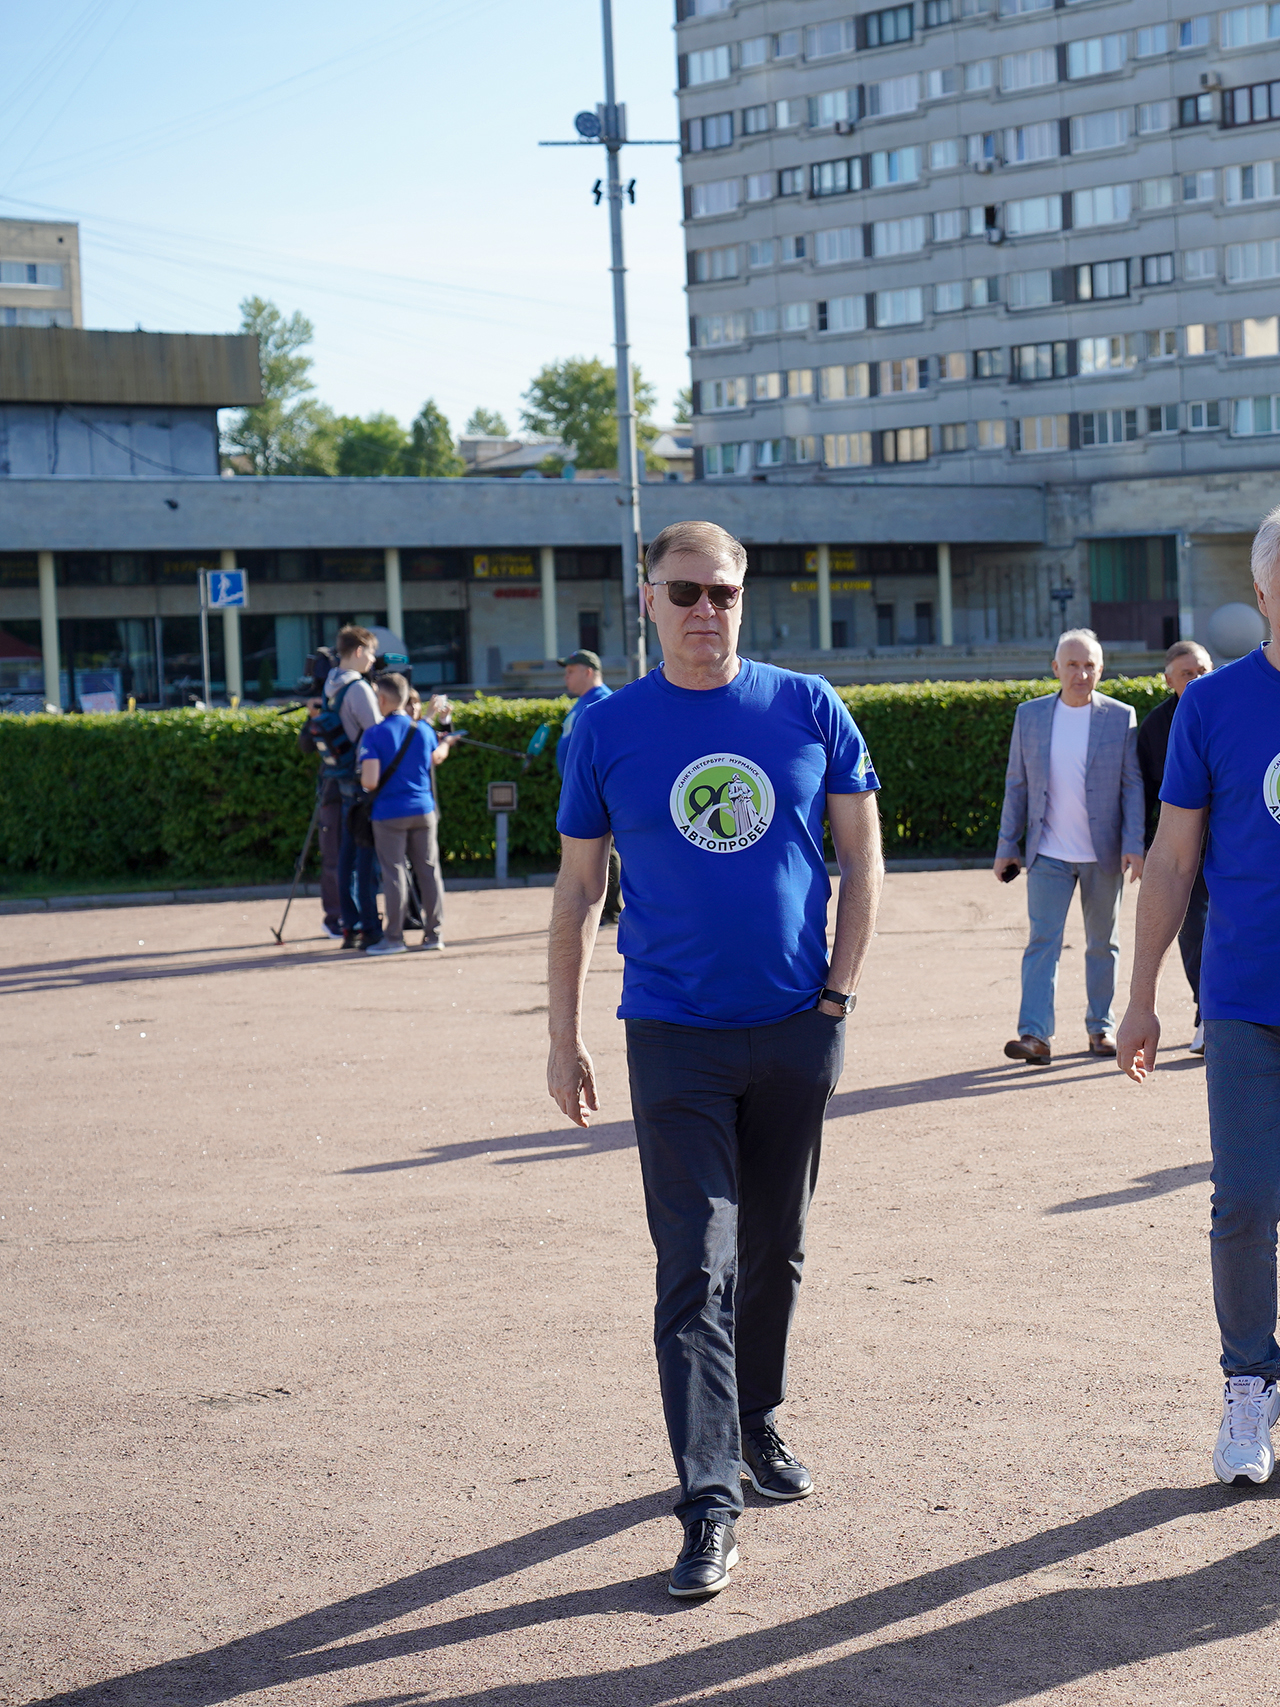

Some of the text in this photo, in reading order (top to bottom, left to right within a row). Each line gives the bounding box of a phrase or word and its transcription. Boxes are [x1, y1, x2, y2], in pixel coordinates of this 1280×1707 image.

[678, 757, 760, 789] САНКТ-ПЕТЕРБУРГ МУРМАНСК
[679, 816, 768, 851] АВТОПРОБЕГ
